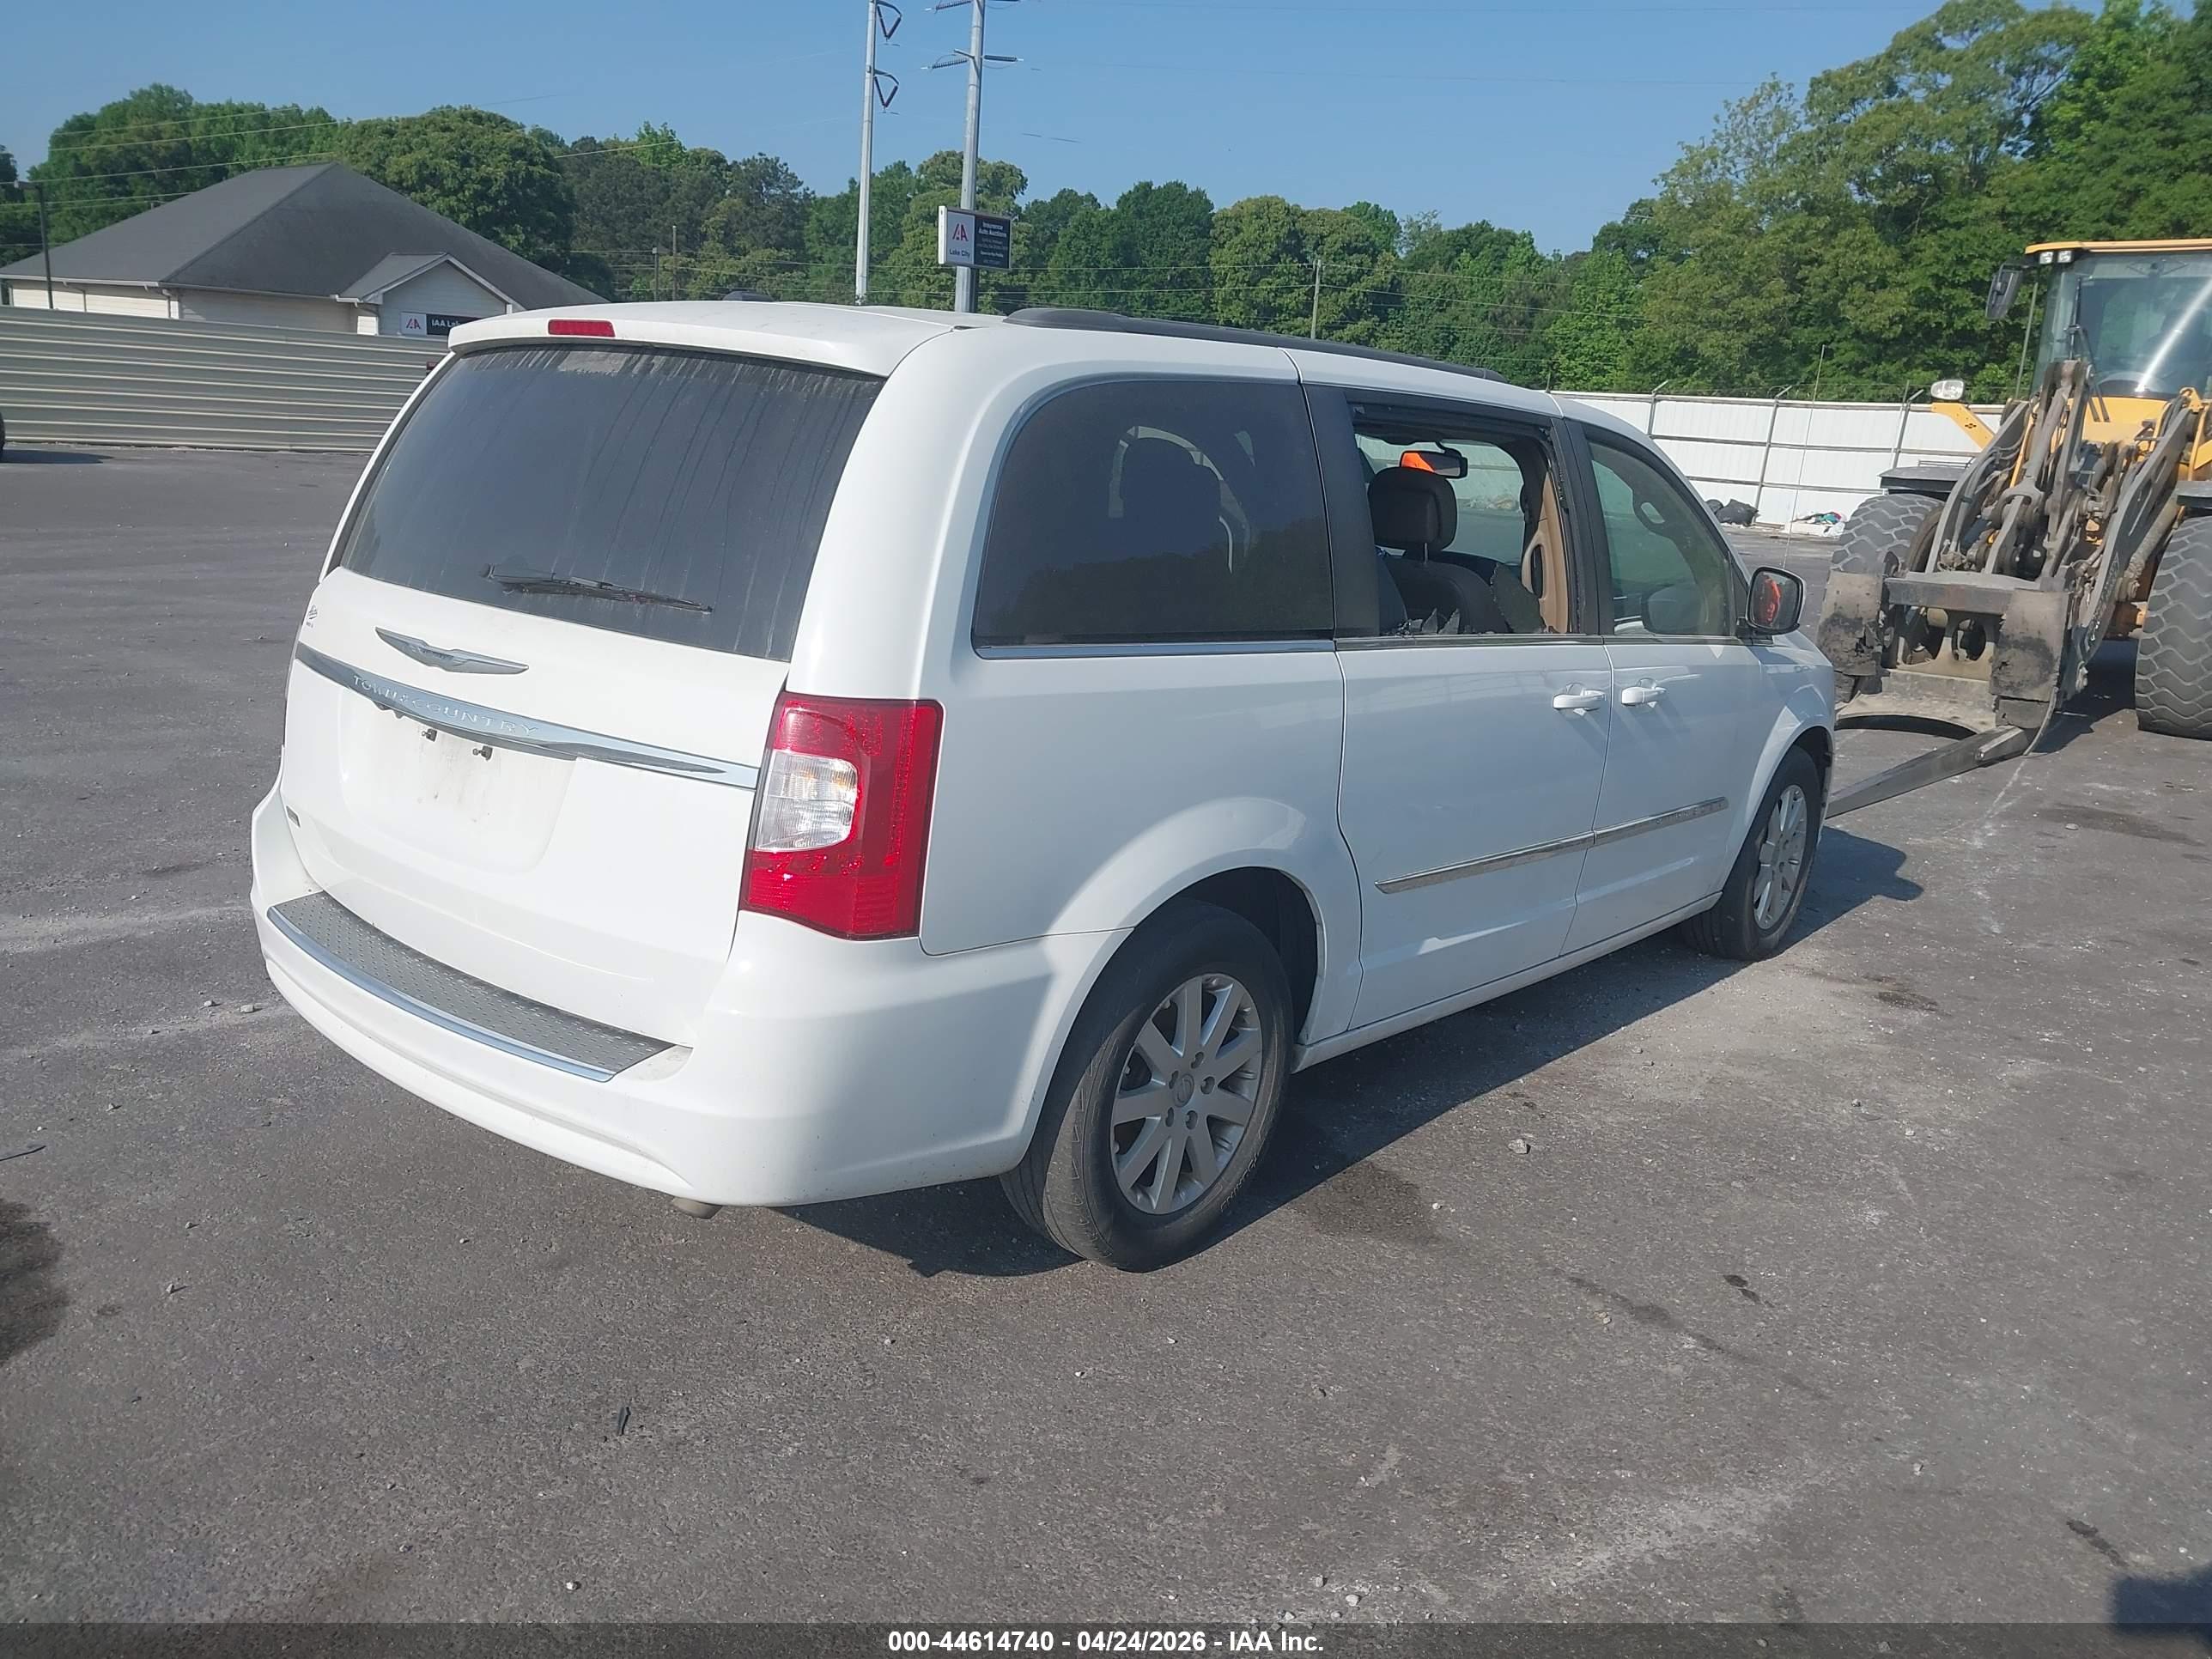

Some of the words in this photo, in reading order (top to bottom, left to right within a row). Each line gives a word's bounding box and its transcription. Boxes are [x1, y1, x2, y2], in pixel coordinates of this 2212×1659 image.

[431, 319, 447, 327] IAA
[353, 675, 398, 700] TOWN
[412, 700, 538, 736] COUNTRY
